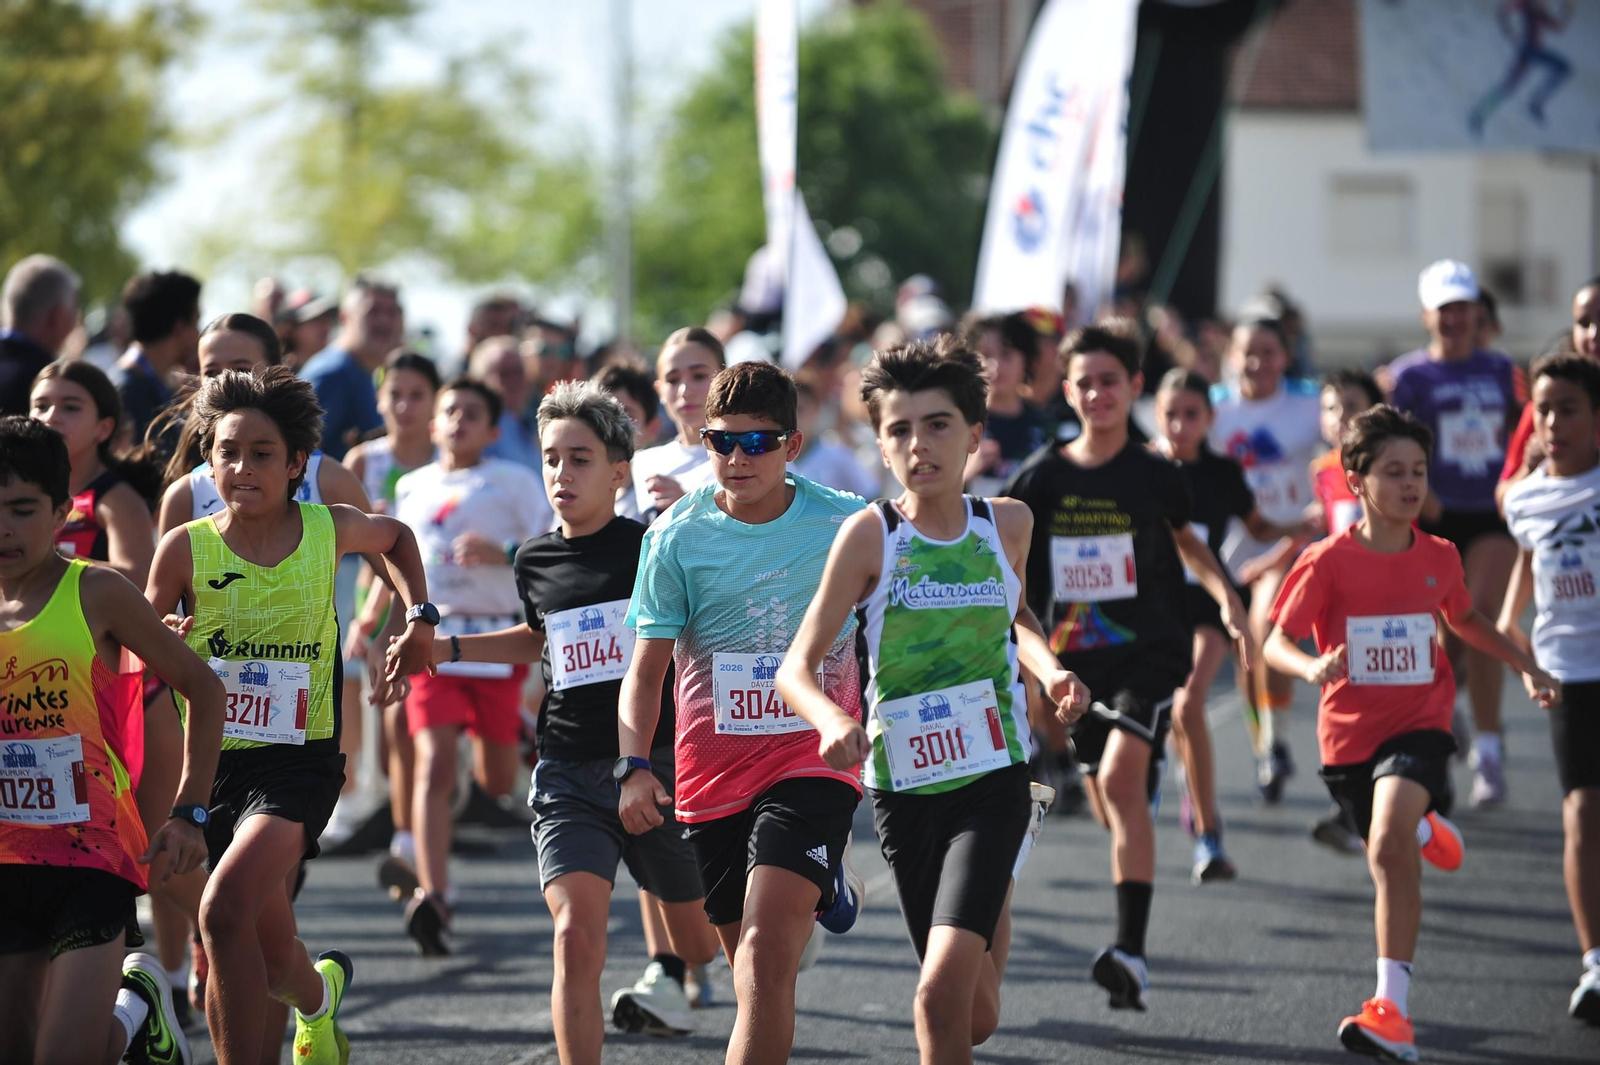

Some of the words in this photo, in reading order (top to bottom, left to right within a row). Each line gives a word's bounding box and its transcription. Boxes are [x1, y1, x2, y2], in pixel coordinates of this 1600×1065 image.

[1063, 563, 1114, 590] 3053
[893, 577, 1005, 607] Natursueño
[551, 620, 571, 631] 2026
[235, 640, 322, 661] Running
[562, 635, 623, 673] 3044
[1366, 644, 1416, 673] 3031
[213, 669, 230, 678] 26
[720, 663, 744, 672] 2026
[241, 685, 256, 693] IAN
[226, 693, 271, 728] 3211
[2, 713, 65, 734] urense
[919, 721, 945, 733] DAKAL
[909, 727, 967, 770] 3011
[0, 777, 56, 810] 028
[805, 850, 829, 869] adidas
